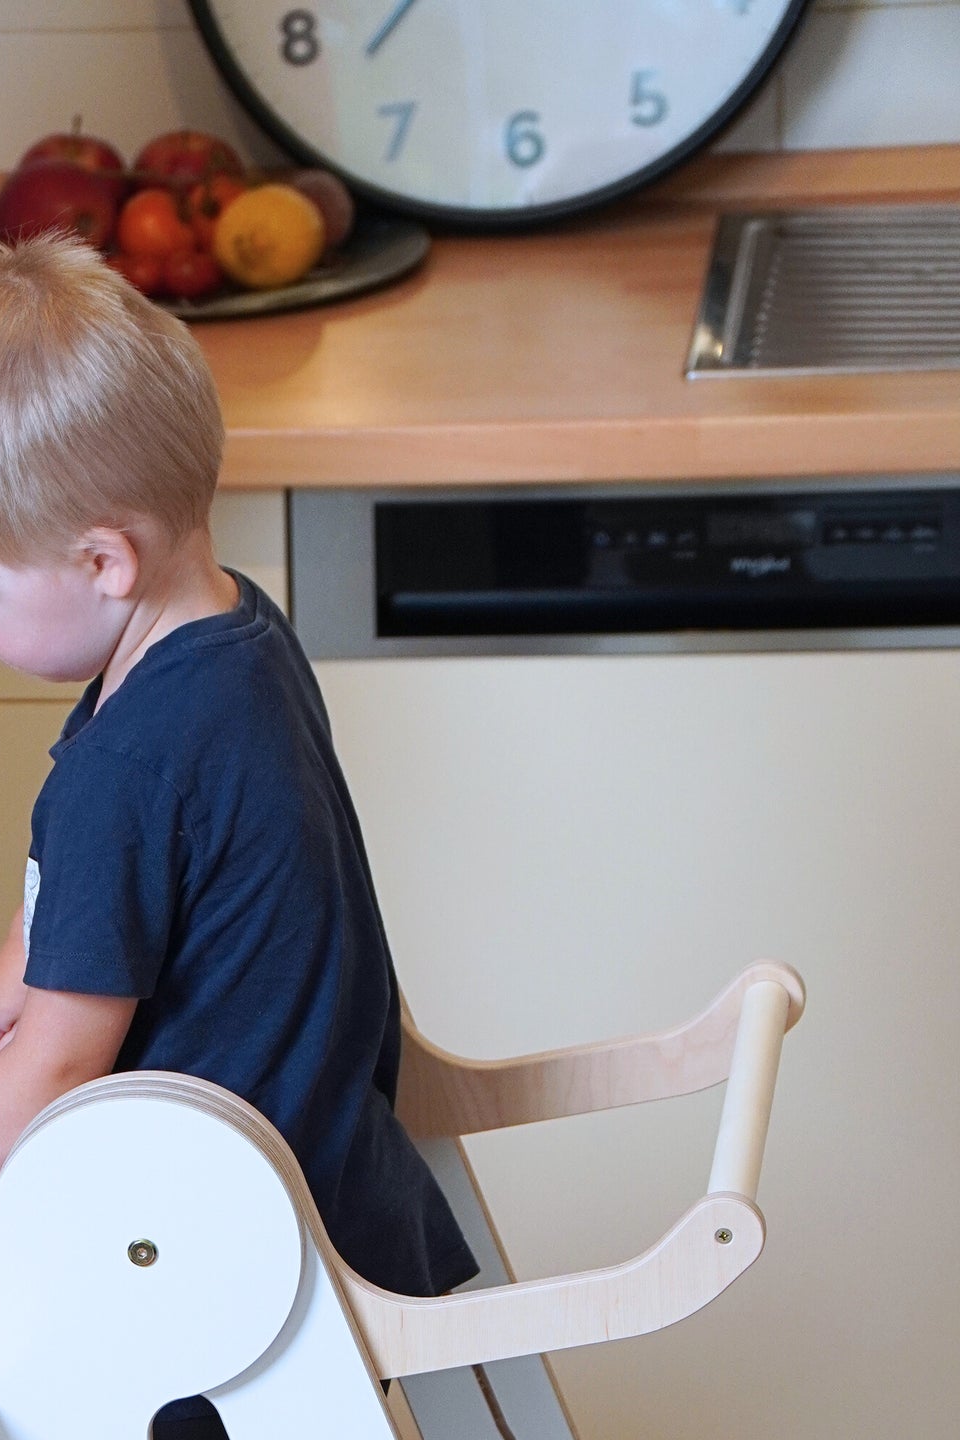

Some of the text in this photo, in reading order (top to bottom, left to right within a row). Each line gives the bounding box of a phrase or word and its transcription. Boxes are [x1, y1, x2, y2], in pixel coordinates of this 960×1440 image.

[281, 9, 319, 67] 8
[630, 69, 670, 128] 5
[377, 102, 415, 162] 7
[505, 110, 545, 169] 6
